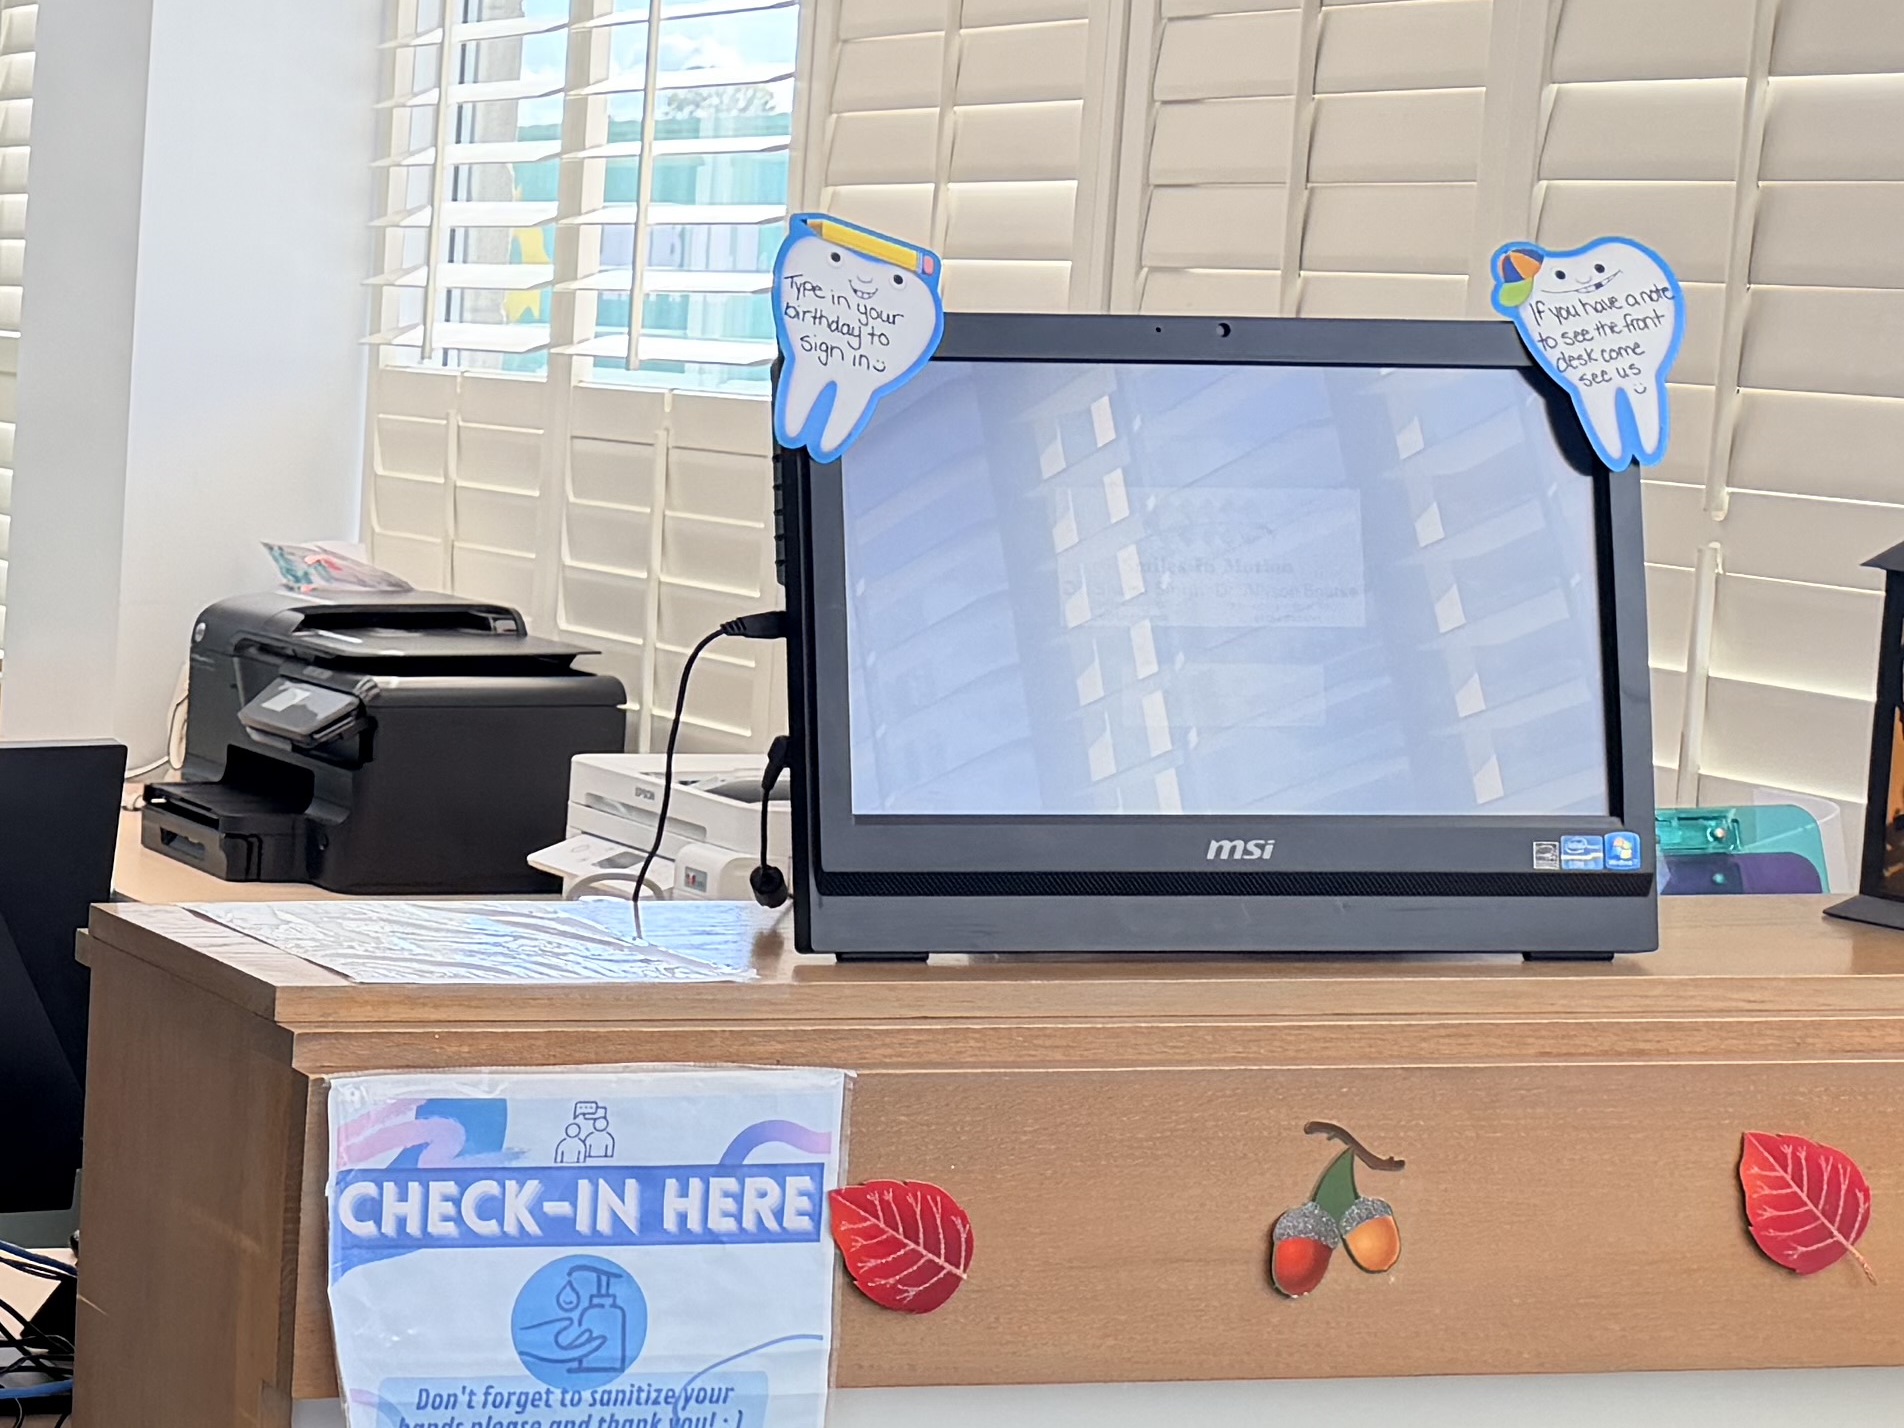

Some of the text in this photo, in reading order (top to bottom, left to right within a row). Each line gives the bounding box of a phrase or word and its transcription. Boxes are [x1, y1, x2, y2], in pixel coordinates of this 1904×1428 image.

[784, 274, 904, 327] Type in your
[1529, 284, 1675, 327] If you have a note
[784, 302, 890, 351] birthday to
[1537, 309, 1665, 351] to see the front
[800, 334, 845, 366] sign
[1556, 341, 1645, 373] desk come
[1579, 363, 1642, 387] see us
[1206, 839, 1275, 860] msi
[338, 1175, 815, 1238] CHECK-IN HERE
[416, 1384, 736, 1417] Don't forget to sanitize your
